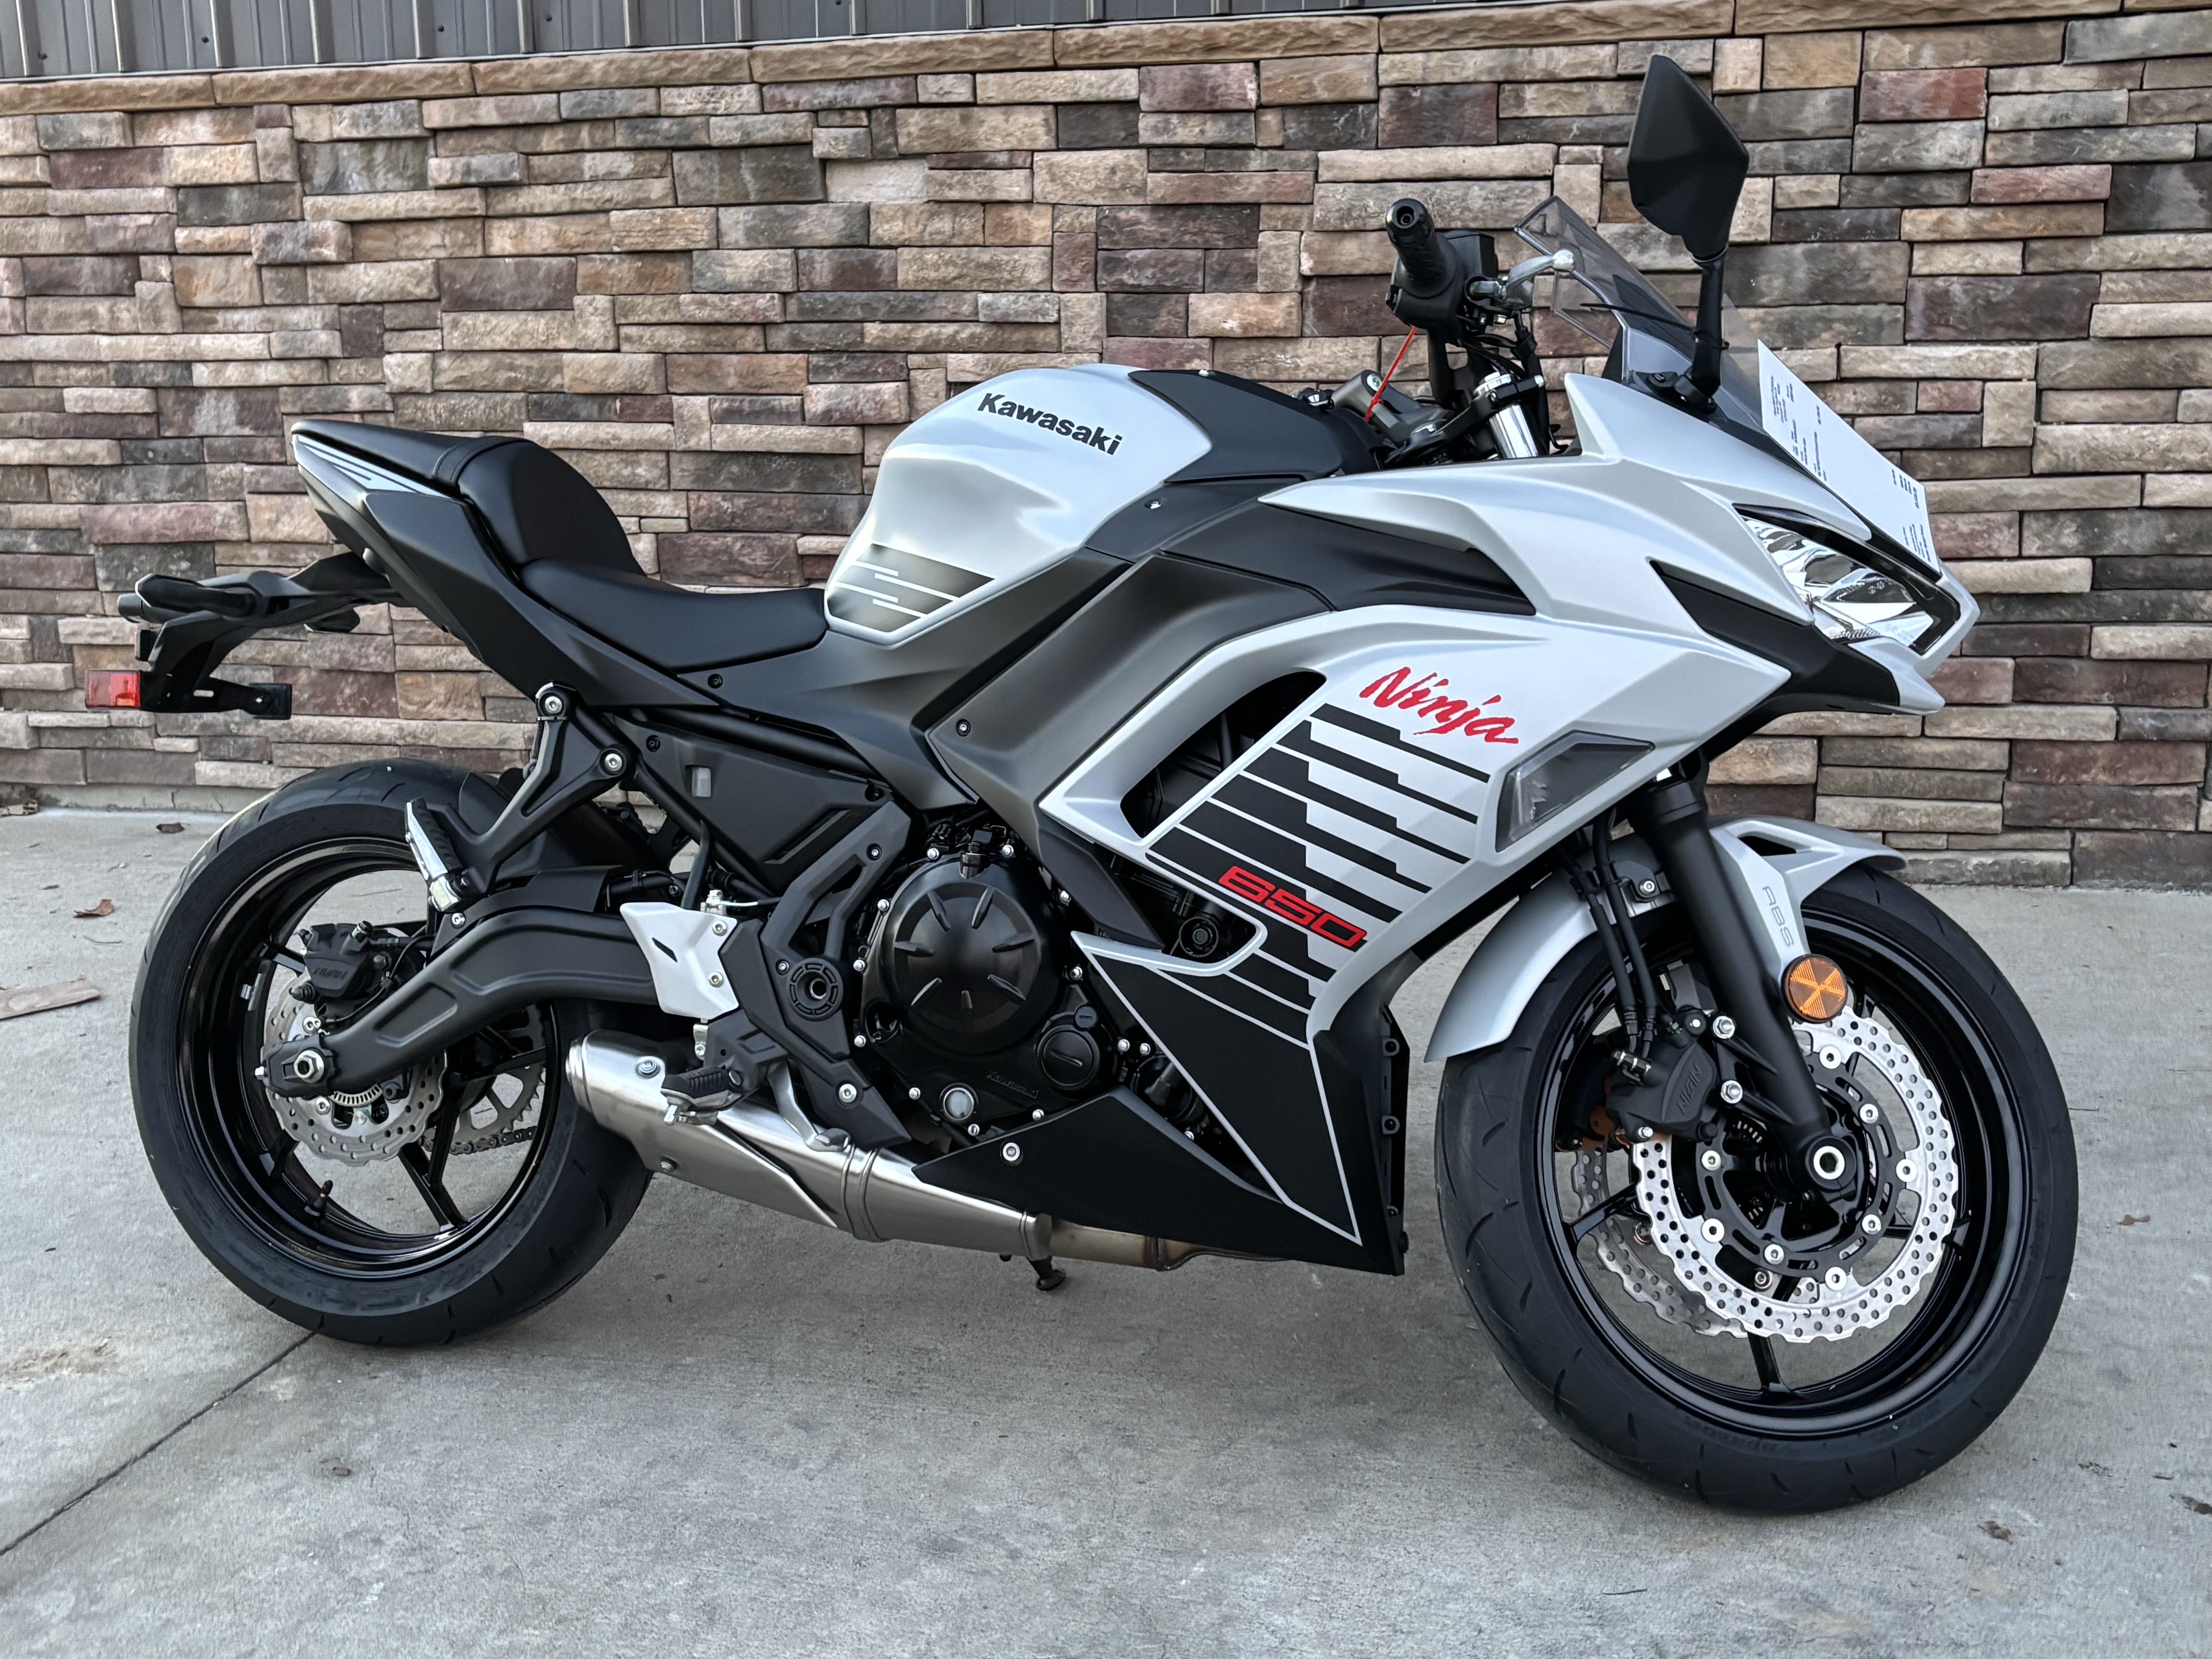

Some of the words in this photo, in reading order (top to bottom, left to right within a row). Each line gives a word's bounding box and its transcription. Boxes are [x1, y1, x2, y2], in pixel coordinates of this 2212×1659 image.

[977, 393, 1123, 455] Kawasaki
[1359, 666, 1519, 744] Ninja
[1219, 866, 1367, 947] 650
[1762, 886, 1794, 946] ABS
